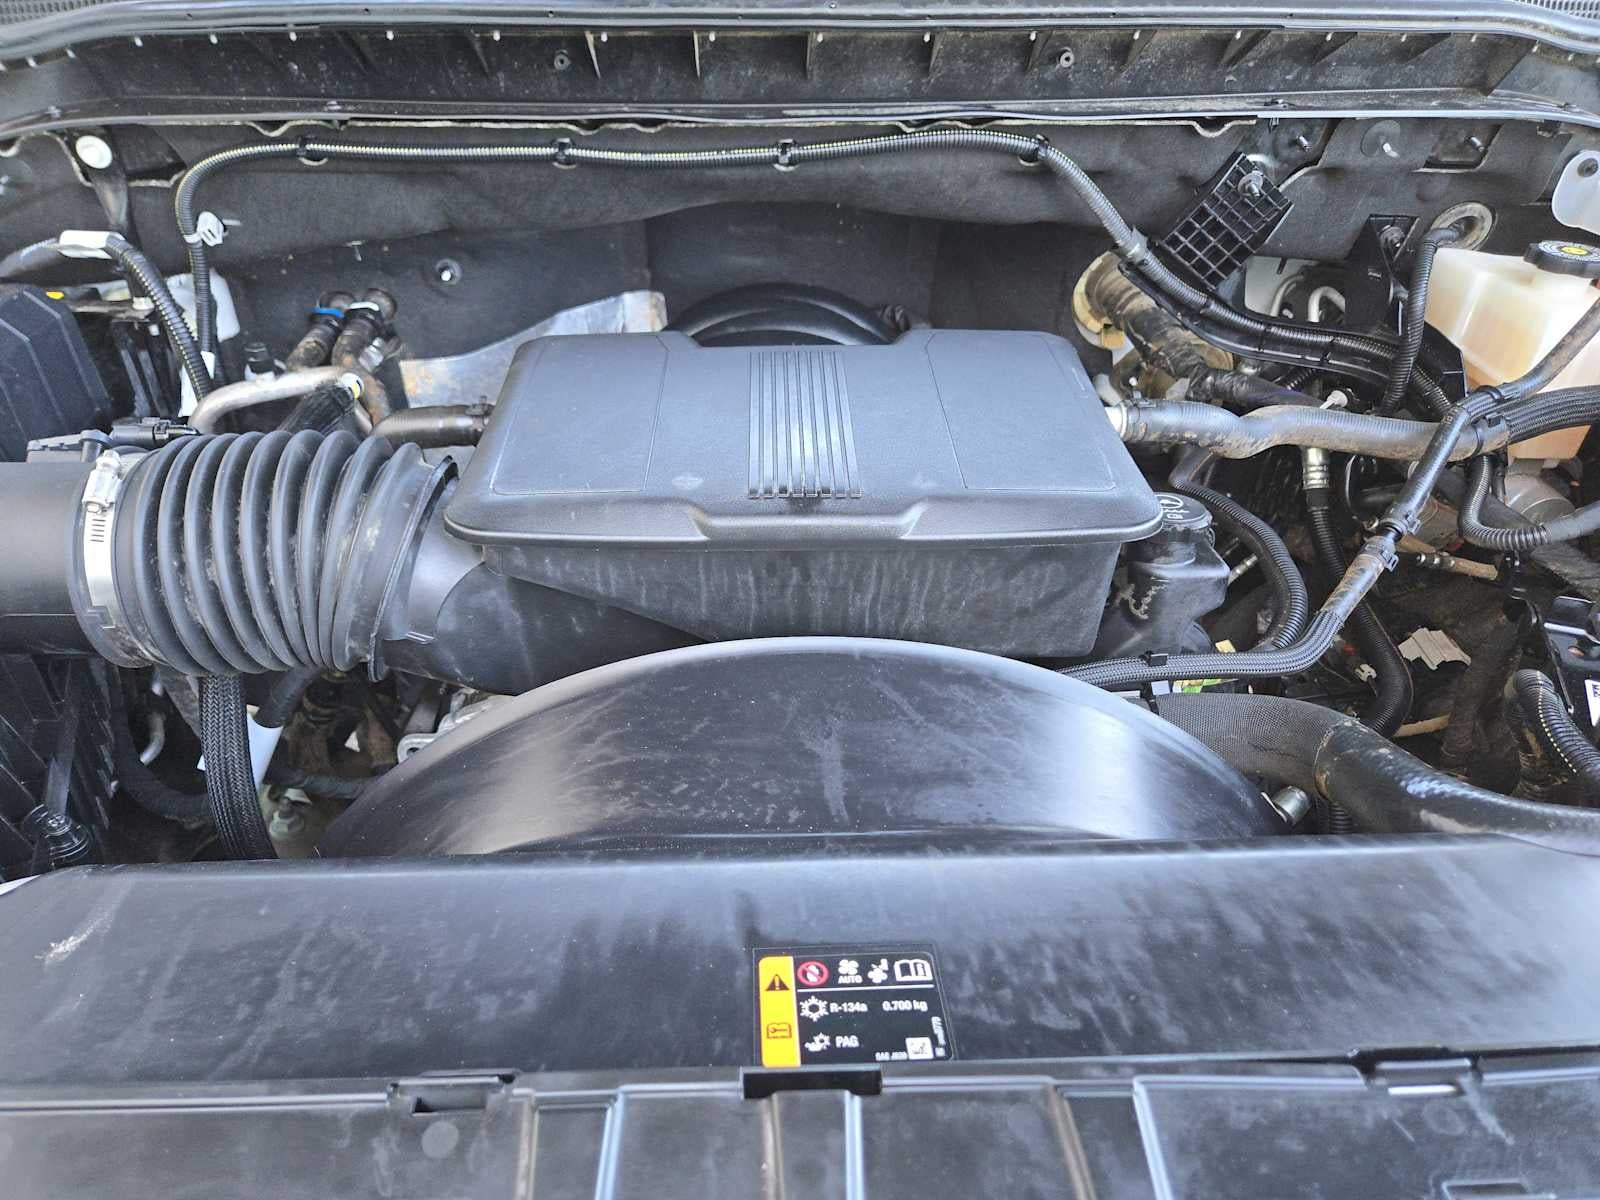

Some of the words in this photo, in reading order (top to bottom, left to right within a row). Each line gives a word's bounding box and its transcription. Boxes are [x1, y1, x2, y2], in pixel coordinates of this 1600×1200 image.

[838, 975, 862, 984] AUTO
[830, 1002, 868, 1012] R-134a
[882, 1001, 912, 1011] 0.700
[913, 1000, 928, 1012] kg
[835, 1036, 859, 1047] PAG
